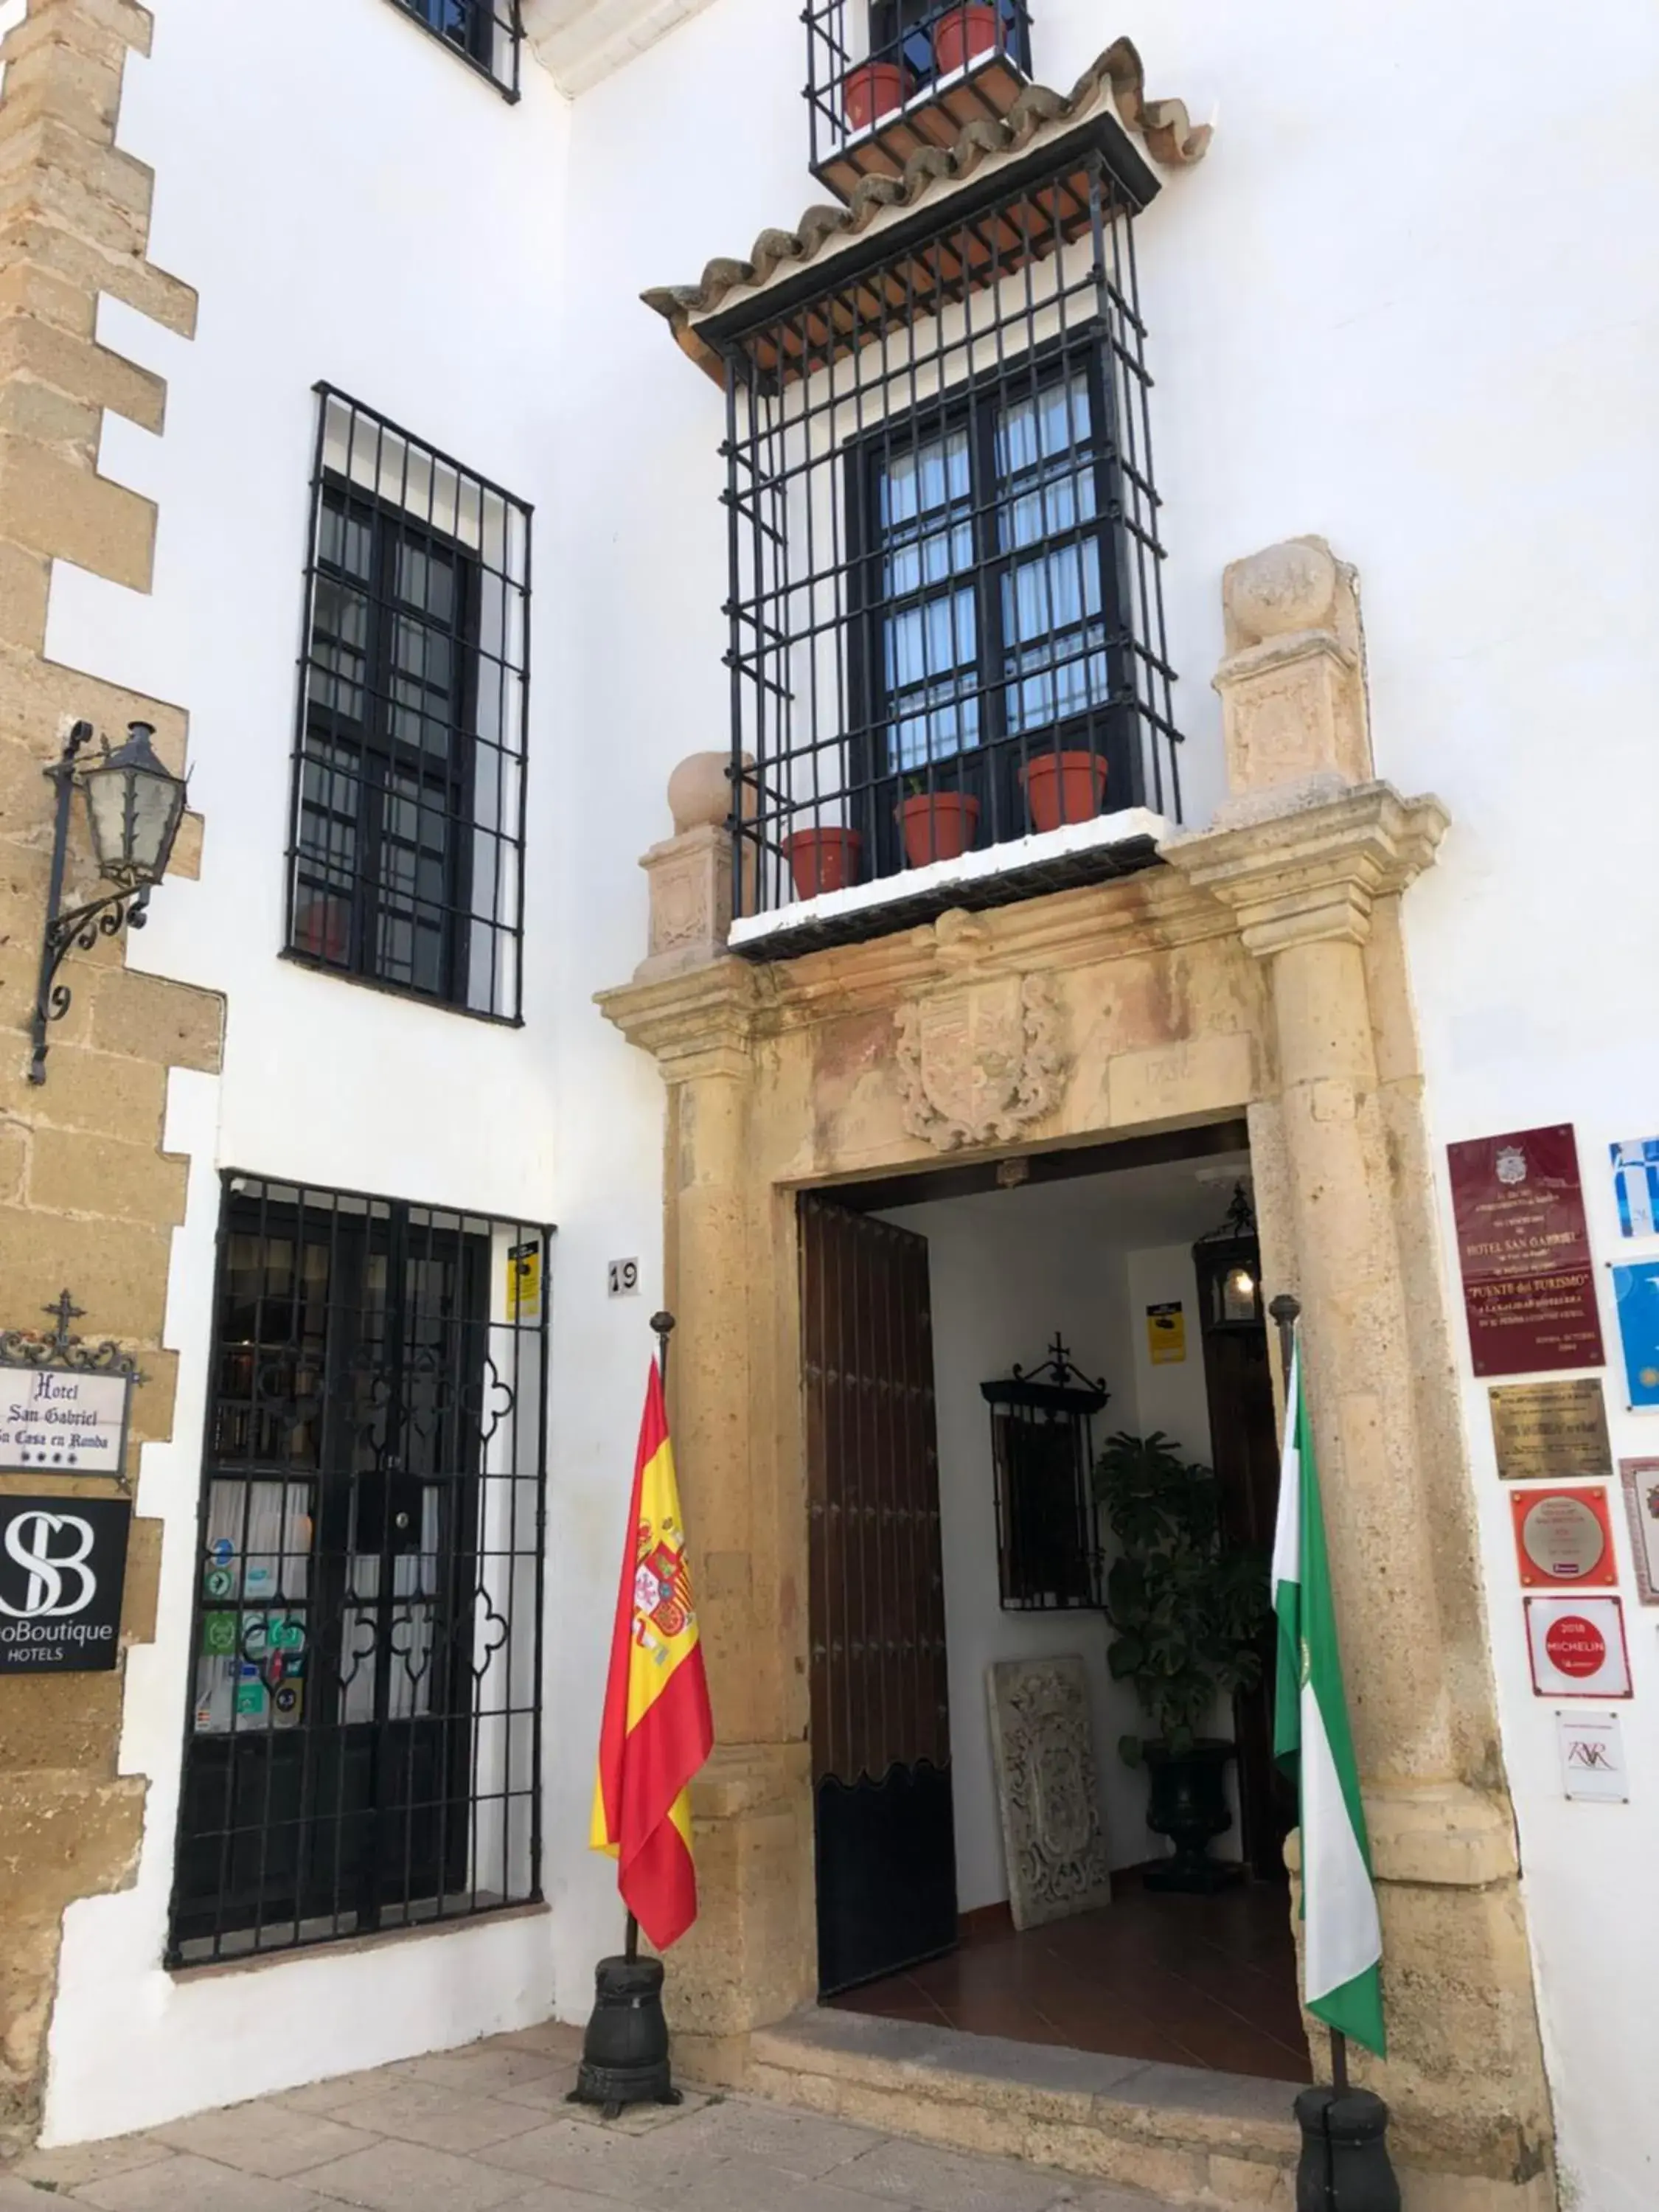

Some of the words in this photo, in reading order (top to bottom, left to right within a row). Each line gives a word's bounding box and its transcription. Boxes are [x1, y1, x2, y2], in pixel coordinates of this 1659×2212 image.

[610, 1262, 638, 1292] 19
[34, 1373, 78, 1401] Hotel
[7, 1404, 38, 1424] San
[44, 1408, 98, 1426] Gabriel
[15, 1430, 46, 1445] Casa
[52, 1435, 65, 1447] en
[69, 1433, 108, 1450] Ronda
[8, 1647, 64, 1663] HOTELS
[1548, 1641, 1604, 1652] MICHELIN
